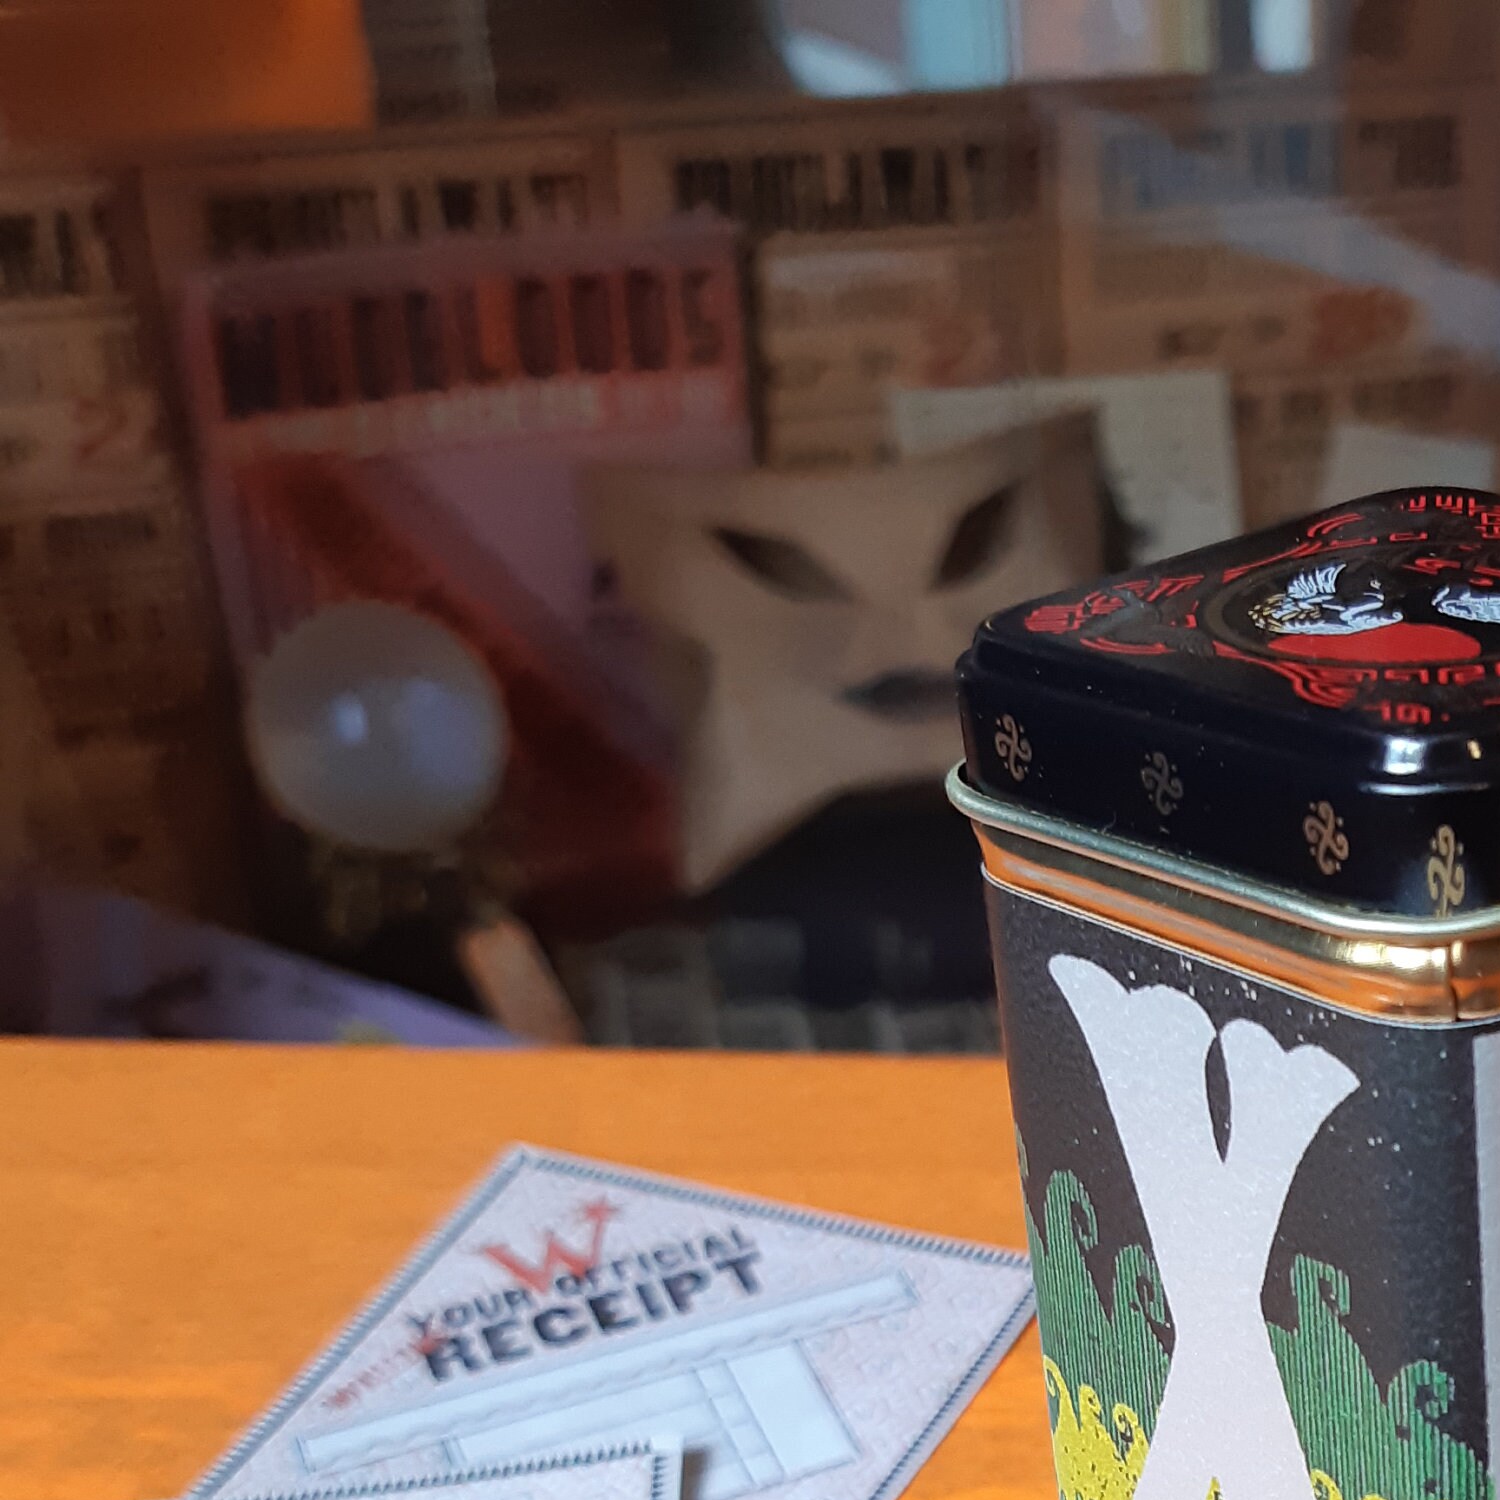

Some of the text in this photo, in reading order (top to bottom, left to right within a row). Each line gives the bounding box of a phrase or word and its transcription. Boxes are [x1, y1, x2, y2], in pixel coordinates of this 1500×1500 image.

[407, 1226, 758, 1334] YOUR OFFICIAL
[423, 1250, 763, 1382] RECEIPT
